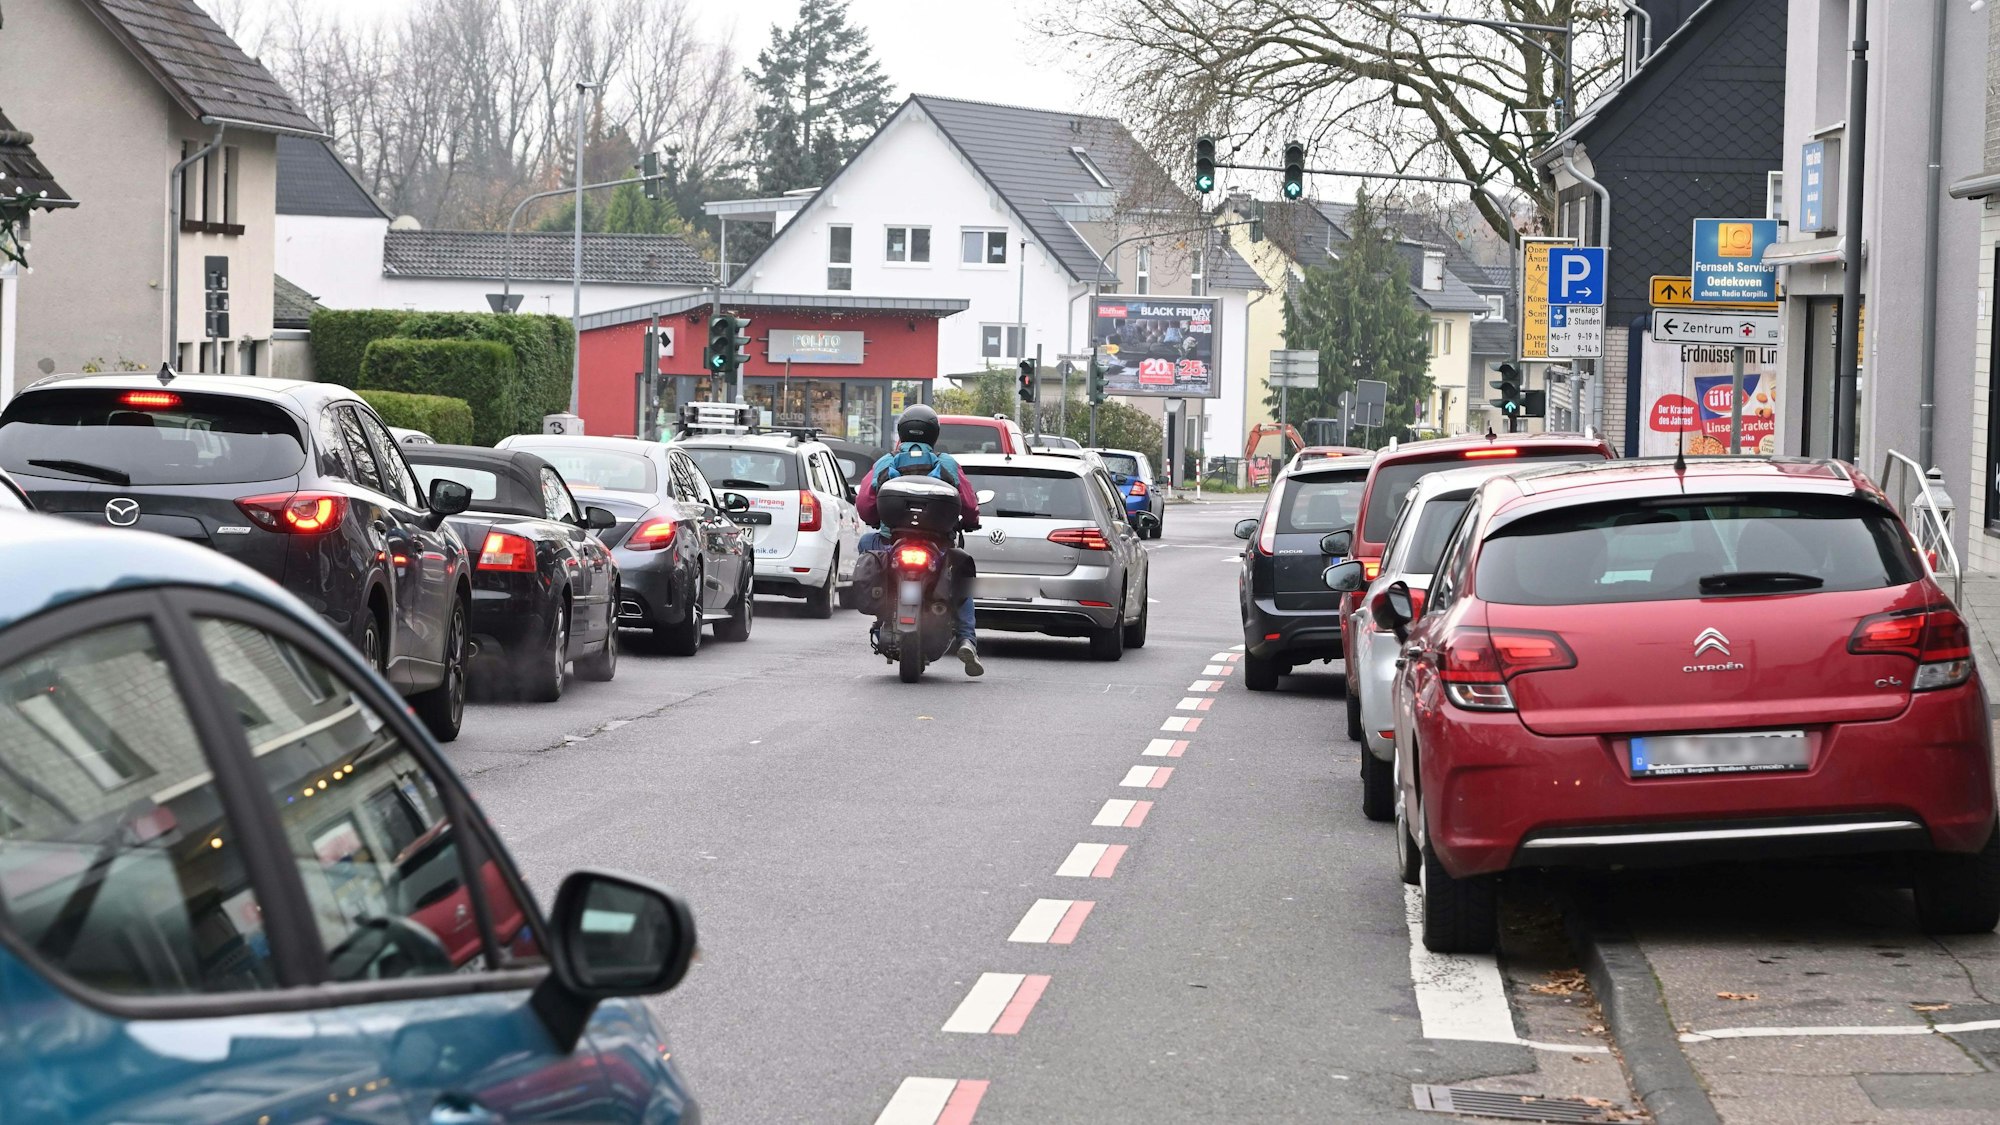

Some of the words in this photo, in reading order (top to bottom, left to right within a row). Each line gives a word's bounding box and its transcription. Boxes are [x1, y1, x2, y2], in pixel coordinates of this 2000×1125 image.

[1528, 254, 1548, 262] ÄNDE
[1696, 262, 1734, 272] Fernseh
[1737, 262, 1775, 273] Service
[1561, 255, 1591, 297] P
[1707, 276, 1762, 287] Oedekoven
[1141, 306, 1174, 316] BLACK
[1176, 307, 1212, 317] FRIDAY
[1569, 307, 1599, 315] werktags
[1683, 322, 1733, 335] Zentrum
[1551, 345, 1559, 353] Sa
[1659, 405, 1669, 413] Der
[1671, 405, 1694, 414] Kracher
[1707, 422, 1732, 433] Linse
[759, 498, 785, 506] irrgang
[1875, 676, 1903, 688] C4
[1636, 757, 1643, 765] D
